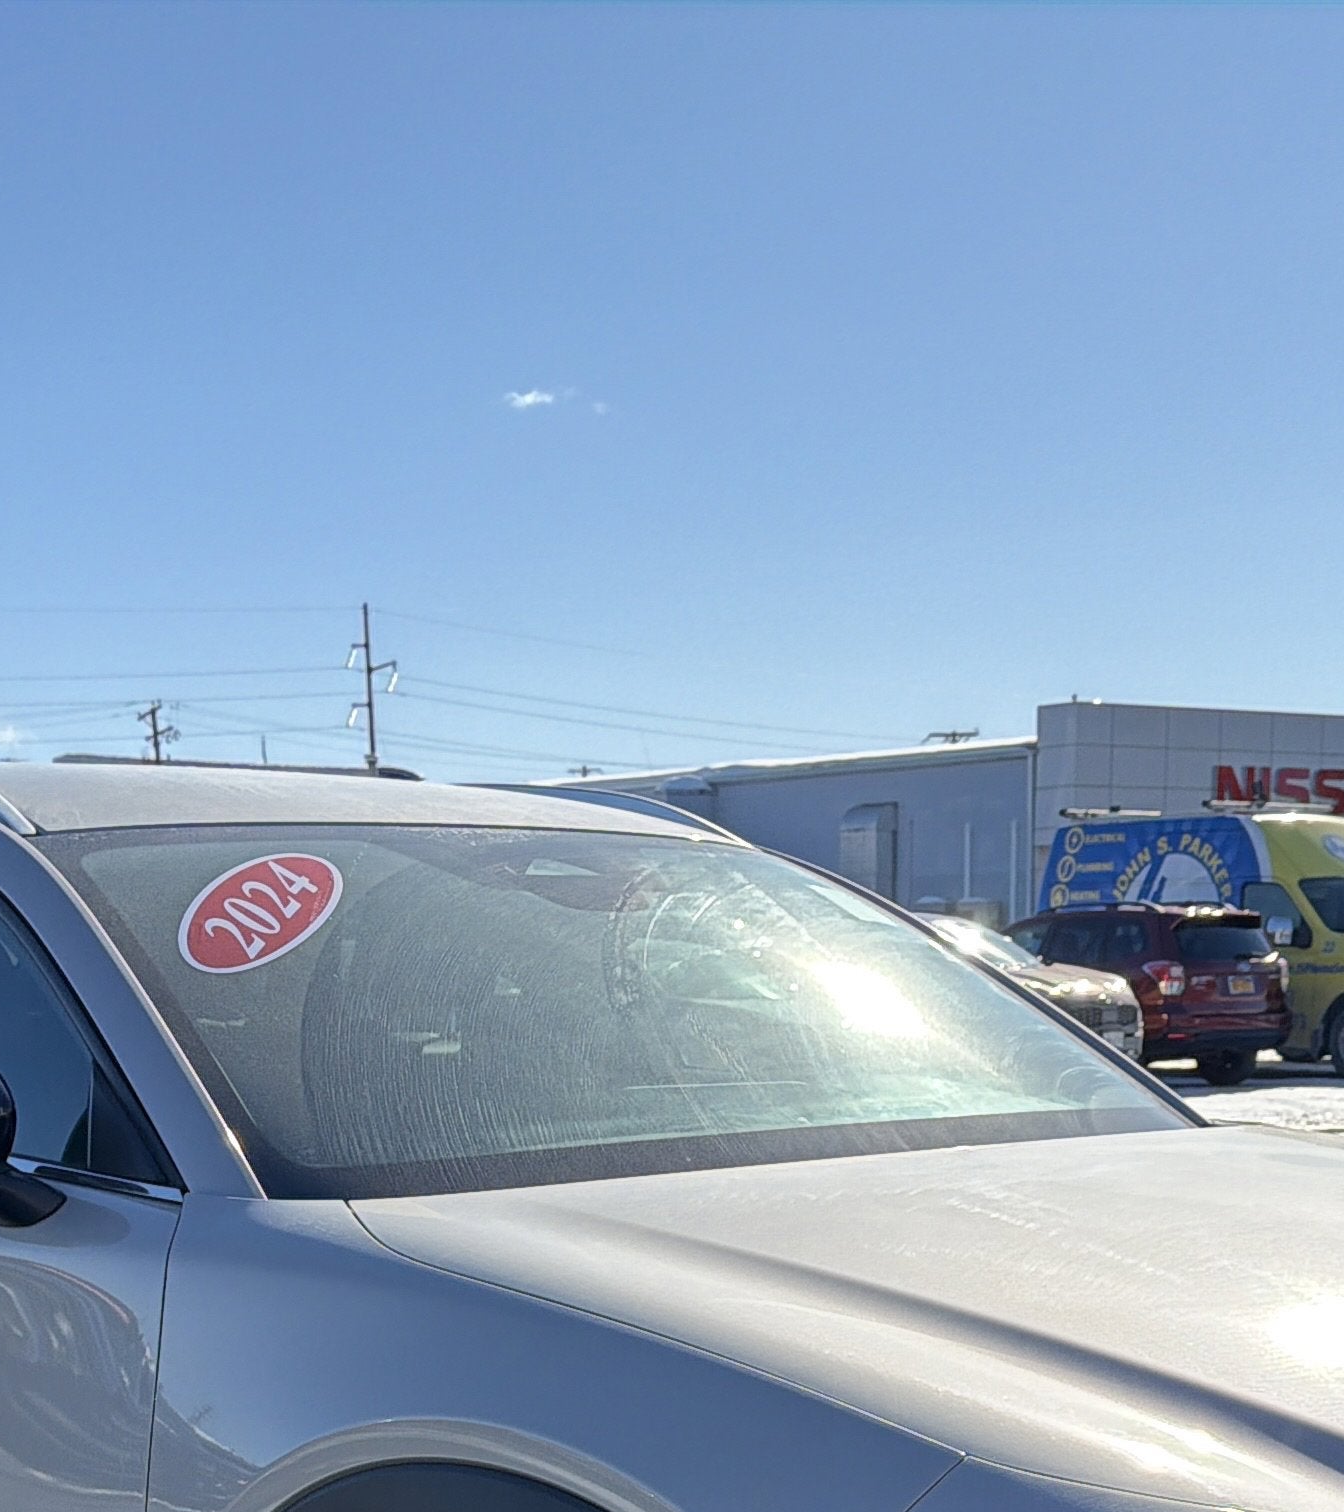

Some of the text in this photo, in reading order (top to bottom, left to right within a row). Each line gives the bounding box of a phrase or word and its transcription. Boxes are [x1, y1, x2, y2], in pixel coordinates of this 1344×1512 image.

[204, 860, 319, 960] 2024
[1112, 834, 1232, 902] JOHN S. PARKER
